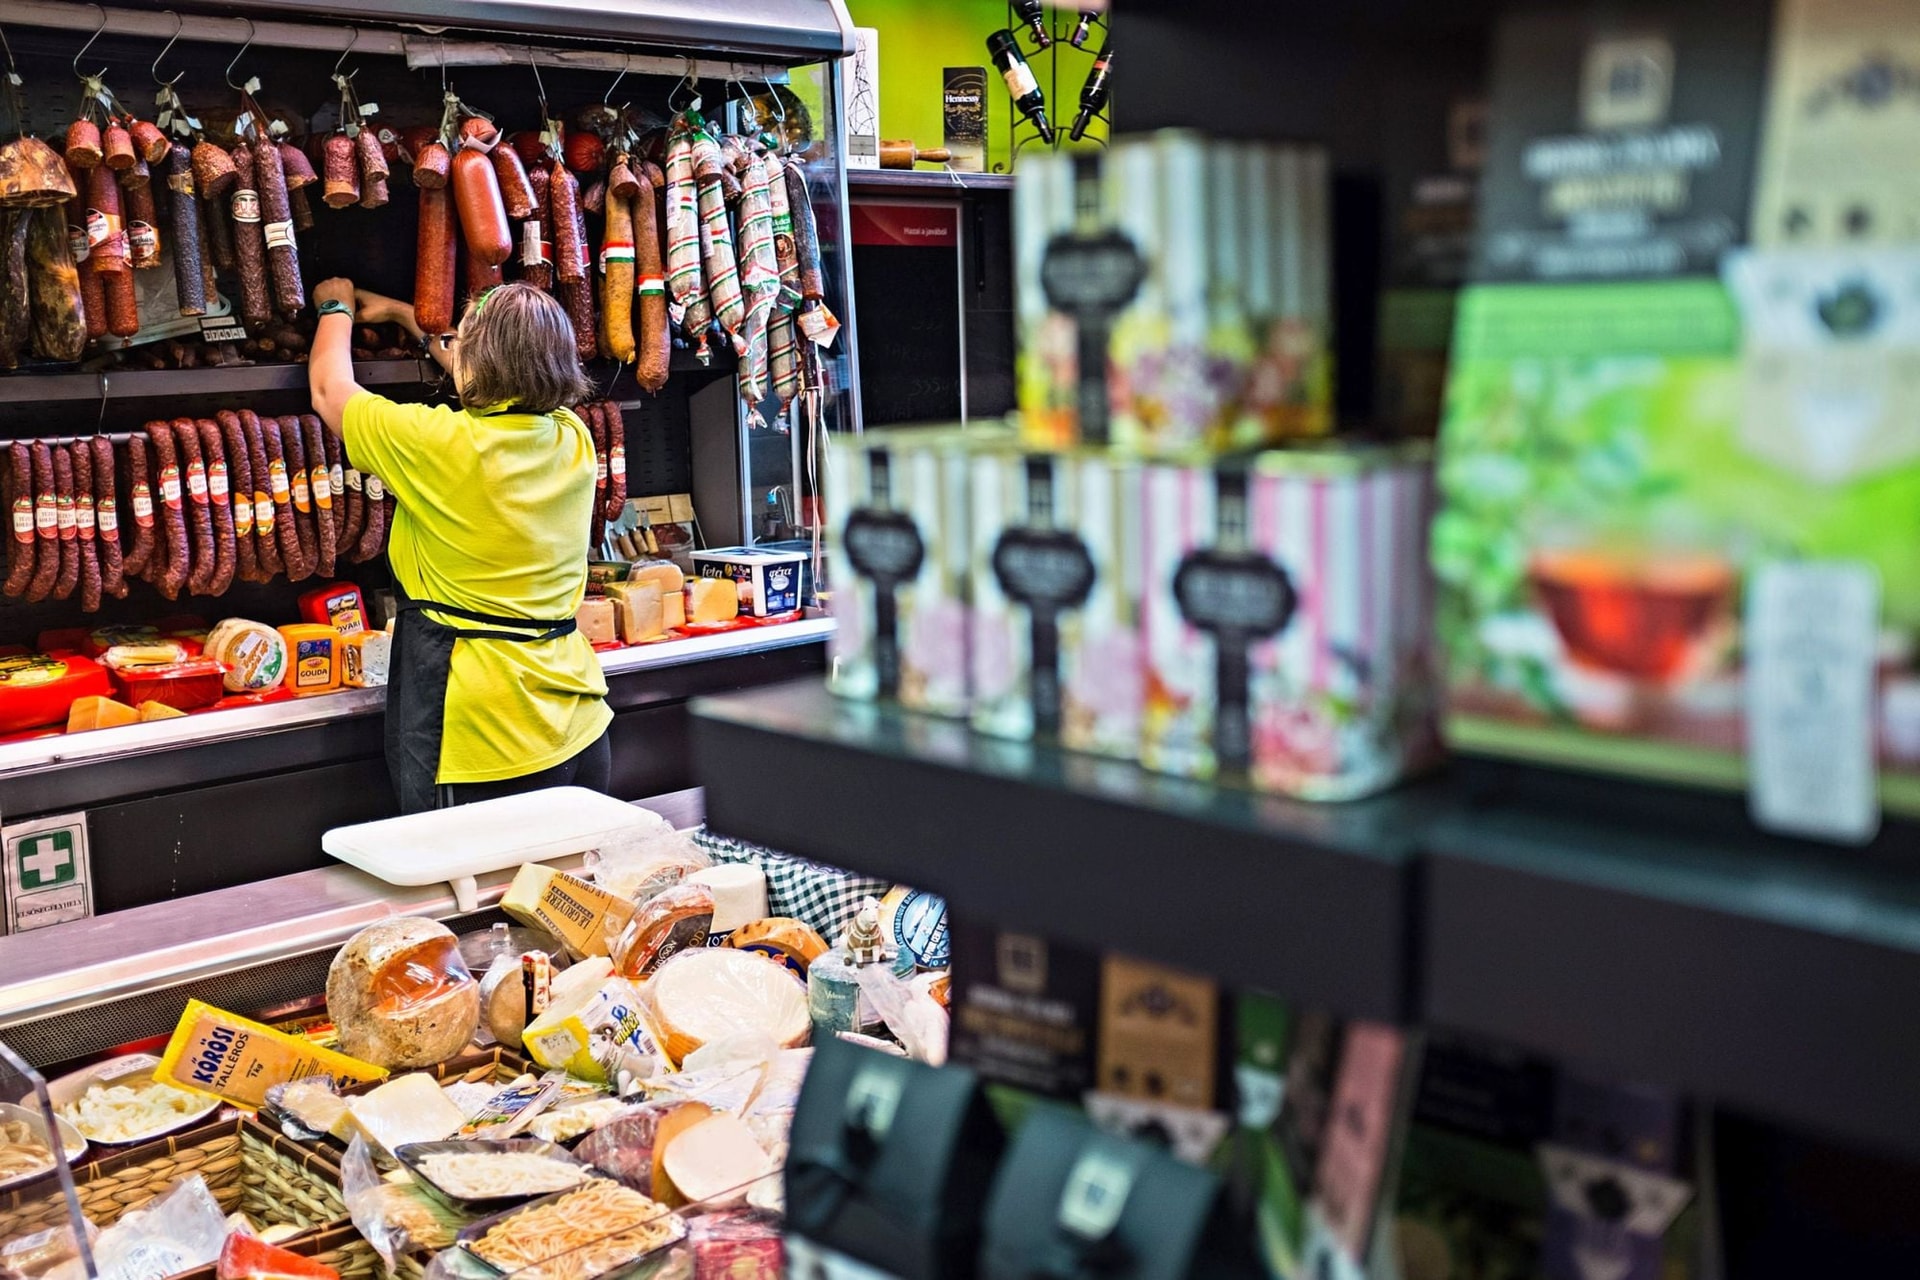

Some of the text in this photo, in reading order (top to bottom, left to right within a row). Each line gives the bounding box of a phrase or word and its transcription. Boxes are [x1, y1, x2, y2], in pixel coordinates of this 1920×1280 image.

[945, 94, 980, 104] Hennessy
[903, 227, 920, 235] Hazai
[702, 563, 723, 578] feta
[300, 668, 328, 678] GOUDA
[579, 917, 592, 930] LE
[191, 1026, 236, 1084] KŐRÖSI
[215, 1033, 249, 1088] TALLÉROS
